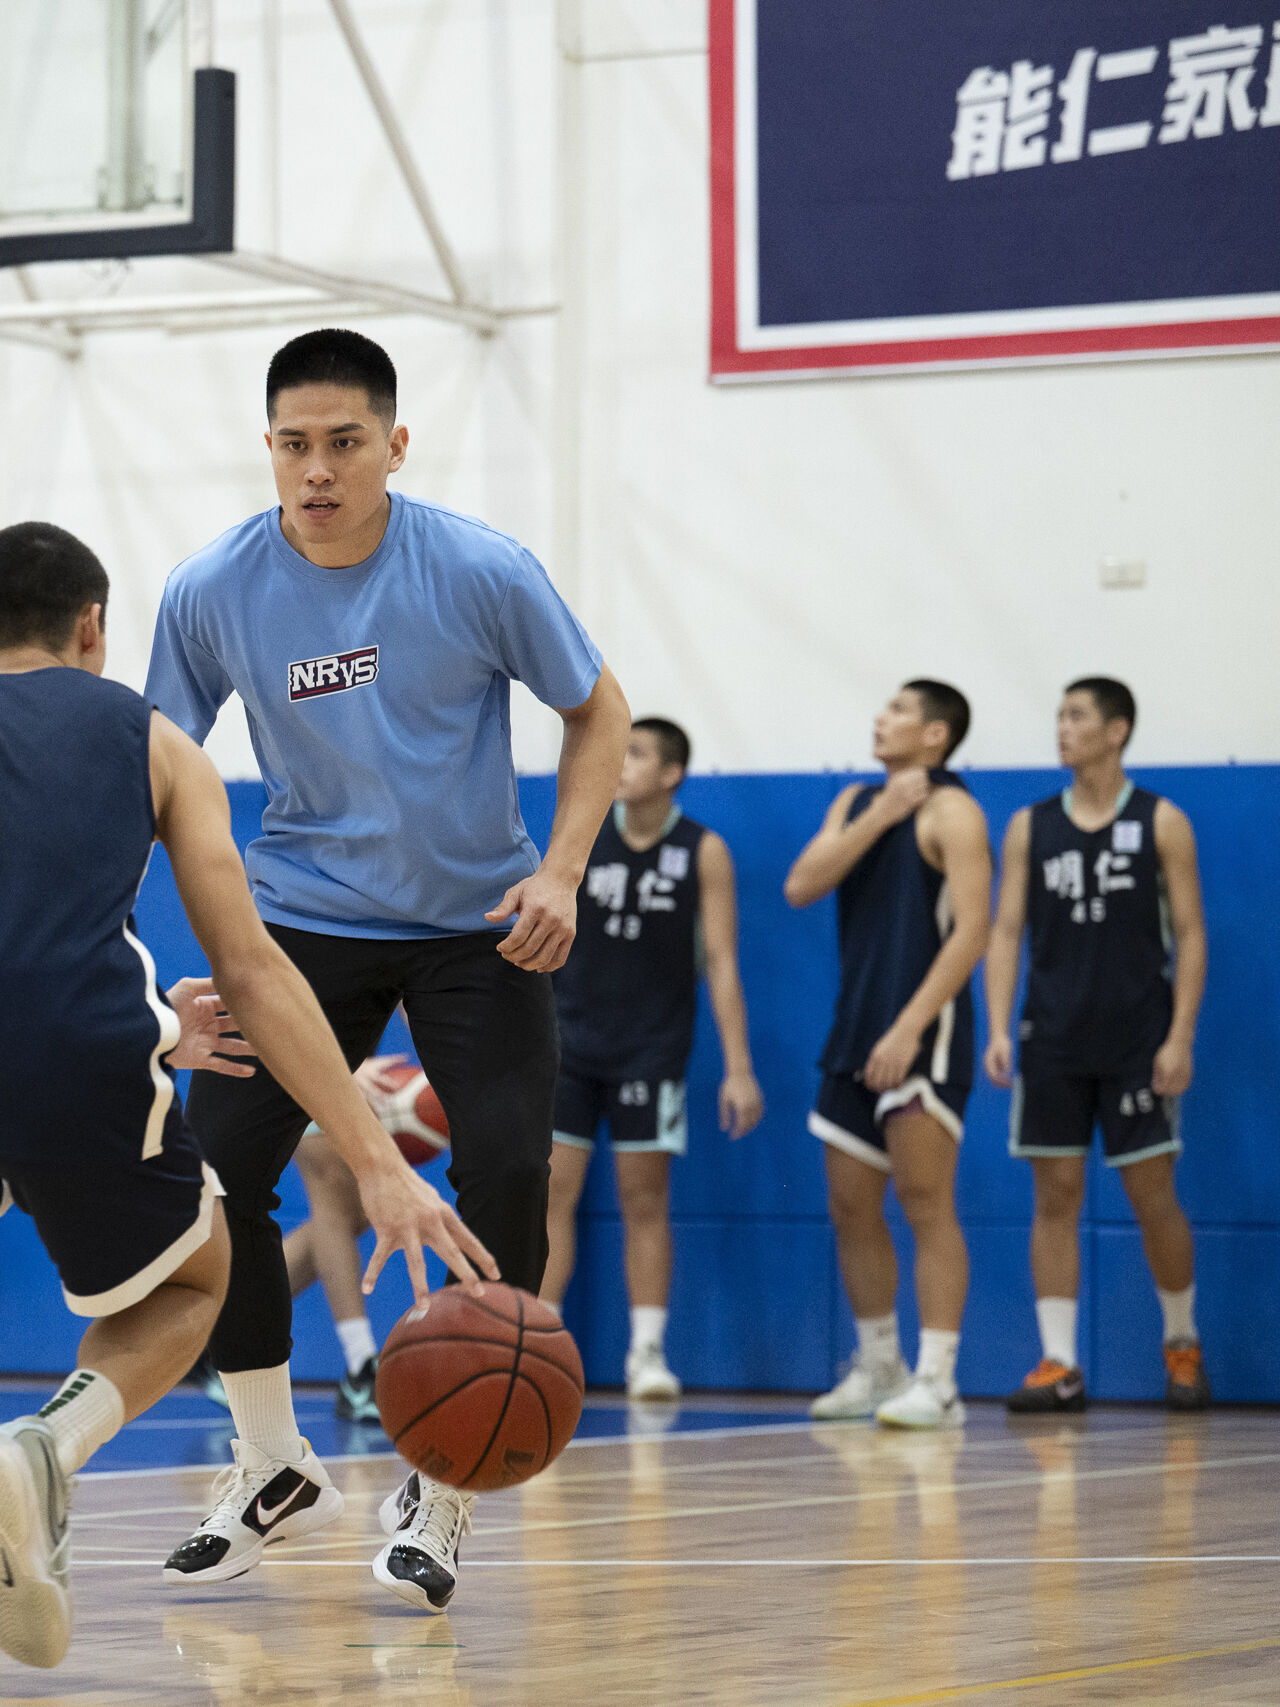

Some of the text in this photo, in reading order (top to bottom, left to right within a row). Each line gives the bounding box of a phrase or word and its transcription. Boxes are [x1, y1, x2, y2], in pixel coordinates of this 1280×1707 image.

[946, 20, 1280, 181] 能仁家
[587, 862, 677, 913] 明仁
[1043, 850, 1135, 899] 明仁
